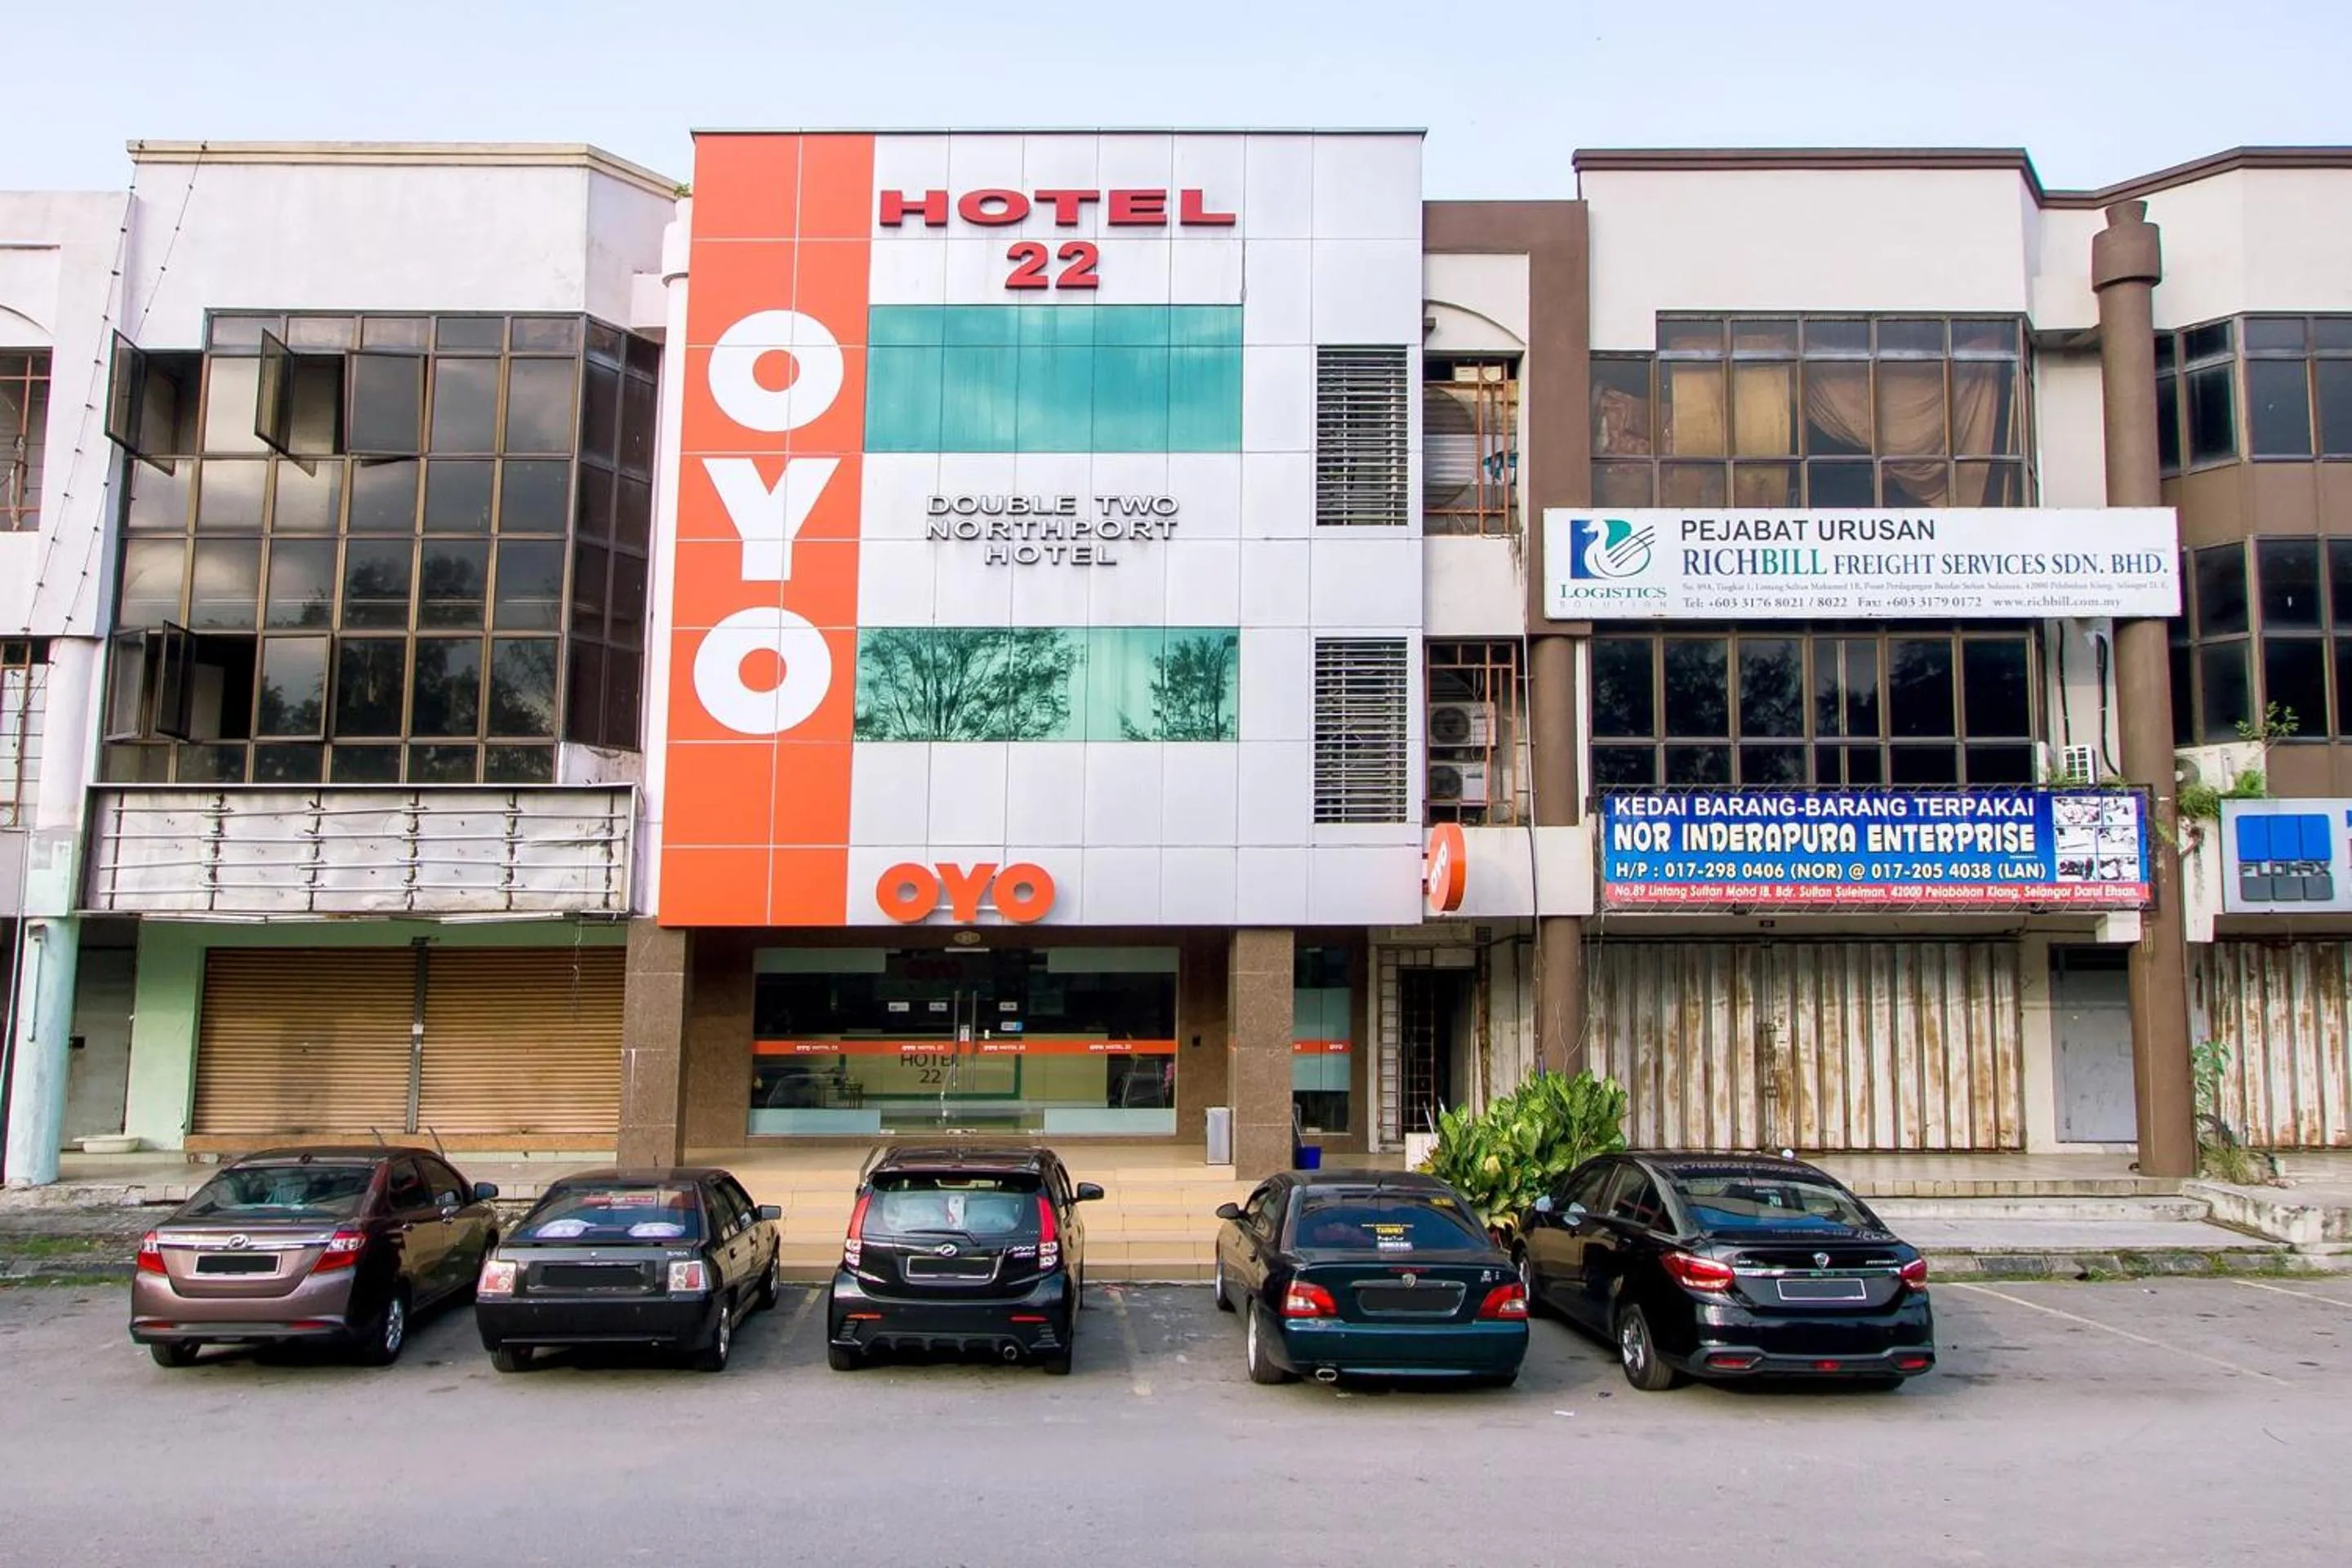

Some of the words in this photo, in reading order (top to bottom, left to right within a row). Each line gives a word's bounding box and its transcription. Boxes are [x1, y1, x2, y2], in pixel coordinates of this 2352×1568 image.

[880, 189, 1236, 227] HOTEL
[1004, 241, 1100, 289] 22
[925, 494, 1077, 516] DOUBLE
[1095, 494, 1179, 516] TWO
[693, 310, 844, 735] OYO
[925, 519, 1178, 541] NORTHPORT
[1682, 519, 1809, 541] PEJABAT
[1818, 519, 1935, 541] URUSAN
[984, 545, 1118, 566] HOTEL
[1682, 549, 1828, 576] RICHBILL
[1834, 555, 1936, 575] FREIGHT
[1942, 554, 2046, 574] SERVICES
[2051, 554, 2104, 574] SDN.
[2111, 554, 2168, 574] BHD.
[1561, 584, 1668, 599] LOGISTICS
[1559, 600, 1668, 608] SOLUTION
[1682, 597, 1704, 608] Tel:
[1708, 597, 1738, 608] +603
[1742, 597, 1771, 608] 3176
[1775, 597, 1804, 608] 8021
[1817, 597, 1848, 608] 8022
[1858, 597, 1882, 608] Fax:
[1886, 597, 1916, 608] +603
[1919, 597, 1949, 608] 3179
[1952, 597, 1982, 608] 0172
[1993, 597, 2122, 608] www.richbill.com.my
[1615, 797, 1686, 817] KEDAI
[1695, 797, 1907, 817] BARANG-BARANG
[1914, 797, 2034, 817] TERPAKAI
[1615, 822, 1671, 853] NOR
[1682, 822, 1855, 853] INDERAPURA
[1868, 822, 2034, 853] ENTERPRISE
[1615, 862, 1648, 880] H/P
[1664, 862, 1737, 880] 017-298
[1742, 862, 1785, 880] 0406
[1790, 862, 1843, 880] (NOR)
[1848, 862, 1866, 880] @
[1871, 862, 1944, 880] 017-205
[1949, 862, 1993, 880] 4038
[1998, 862, 2047, 880] (LAN)
[876, 862, 1056, 924] OYO
[1615, 884, 1646, 897] No.89
[1649, 884, 1686, 899] Lintang
[1690, 884, 1723, 897] Sultan
[1726, 884, 1757, 897] Mohd
[1800, 884, 1832, 897] Sultan
[1891, 884, 1922, 897] 42000
[2024, 884, 2071, 899] Selangor
[2074, 884, 2103, 897] Darul
[900, 1054, 960, 1067] HOTEL
[919, 1070, 942, 1084] 22
